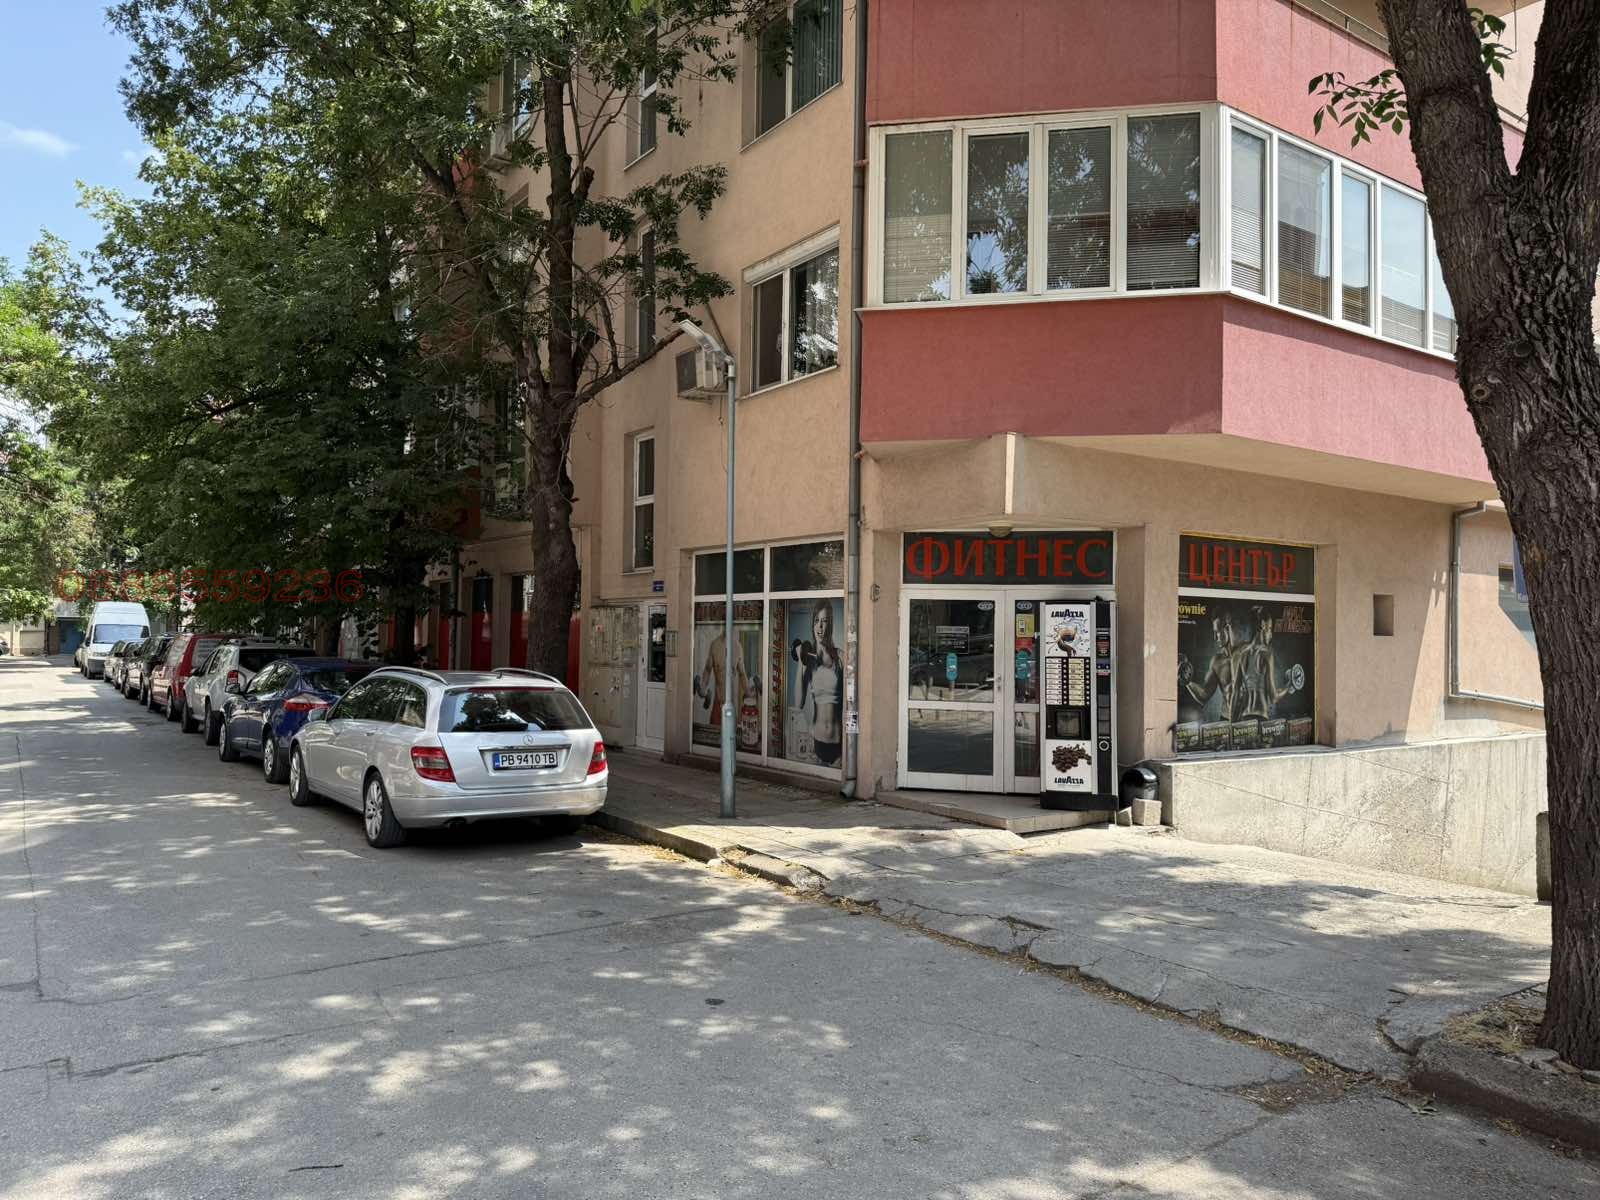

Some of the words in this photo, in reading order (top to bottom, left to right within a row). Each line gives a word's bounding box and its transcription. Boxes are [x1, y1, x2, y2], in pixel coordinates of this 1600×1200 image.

[906, 536, 1109, 582] ФИТНЕС
[1186, 543, 1297, 591] ЦЕНТЪР
[1050, 608, 1085, 619] LAVAZZA
[1178, 603, 1207, 616] ownie
[500, 754, 515, 766] PB
[516, 753, 541, 765] 9410
[543, 752, 555, 764] TB
[1054, 775, 1085, 785] LAVAZZA
